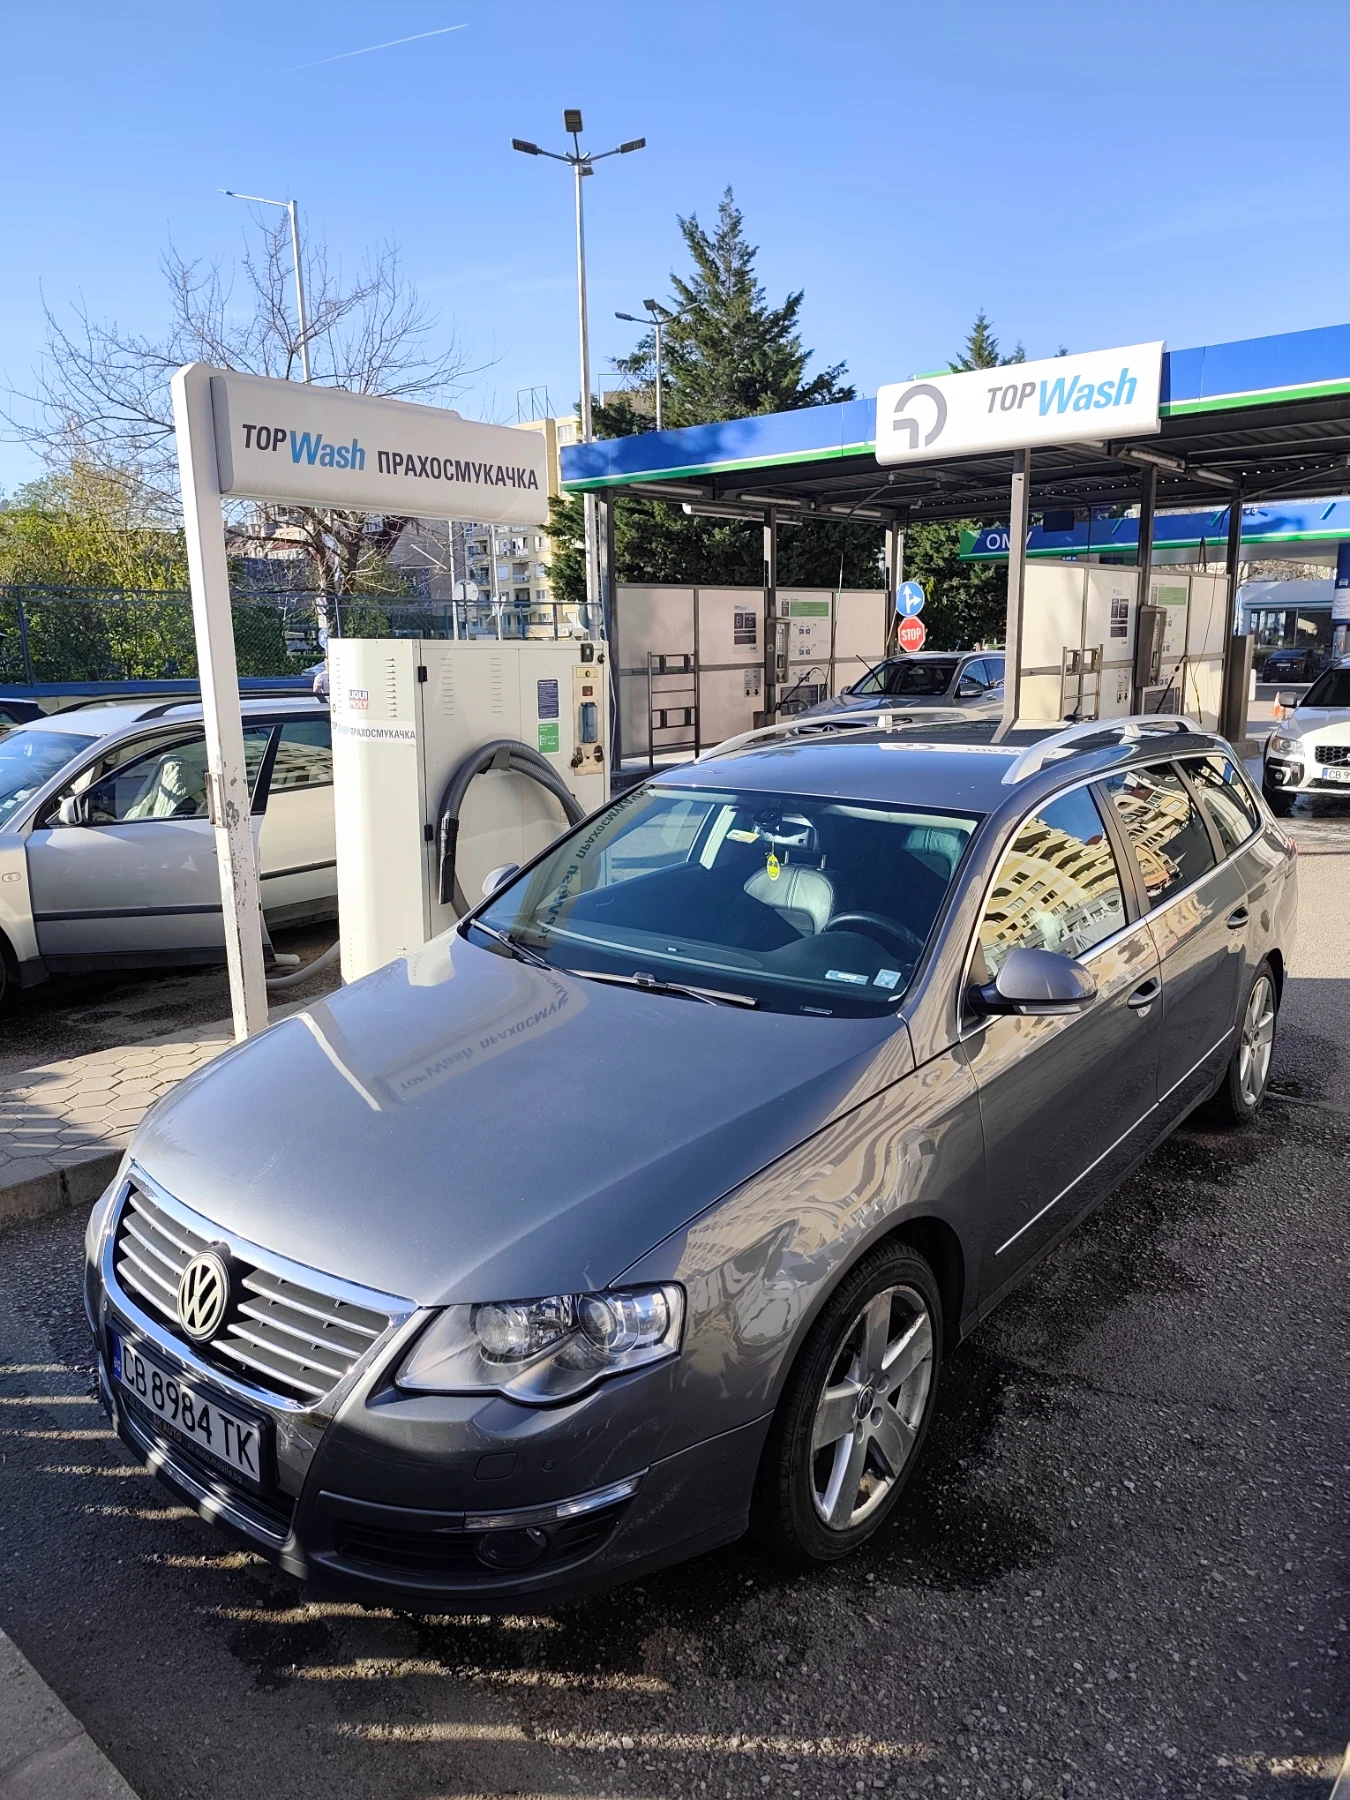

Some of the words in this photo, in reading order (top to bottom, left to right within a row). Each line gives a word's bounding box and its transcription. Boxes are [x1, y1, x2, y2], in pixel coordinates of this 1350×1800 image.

[987, 381, 1036, 414] TOP
[1039, 367, 1138, 417] Wash
[242, 423, 287, 452] TOP
[289, 430, 366, 471] Wash
[377, 450, 539, 490] ПРАХОСМУКАЧКА
[901, 627, 921, 642] STOP
[350, 727, 416, 740] ПРАХОСМУКАЧКА
[113, 1357, 121, 1372] BG
[123, 1345, 147, 1398] CB
[151, 1370, 213, 1446] 8984
[217, 1410, 256, 1474] TK
[163, 1422, 182, 1443] AUTO
